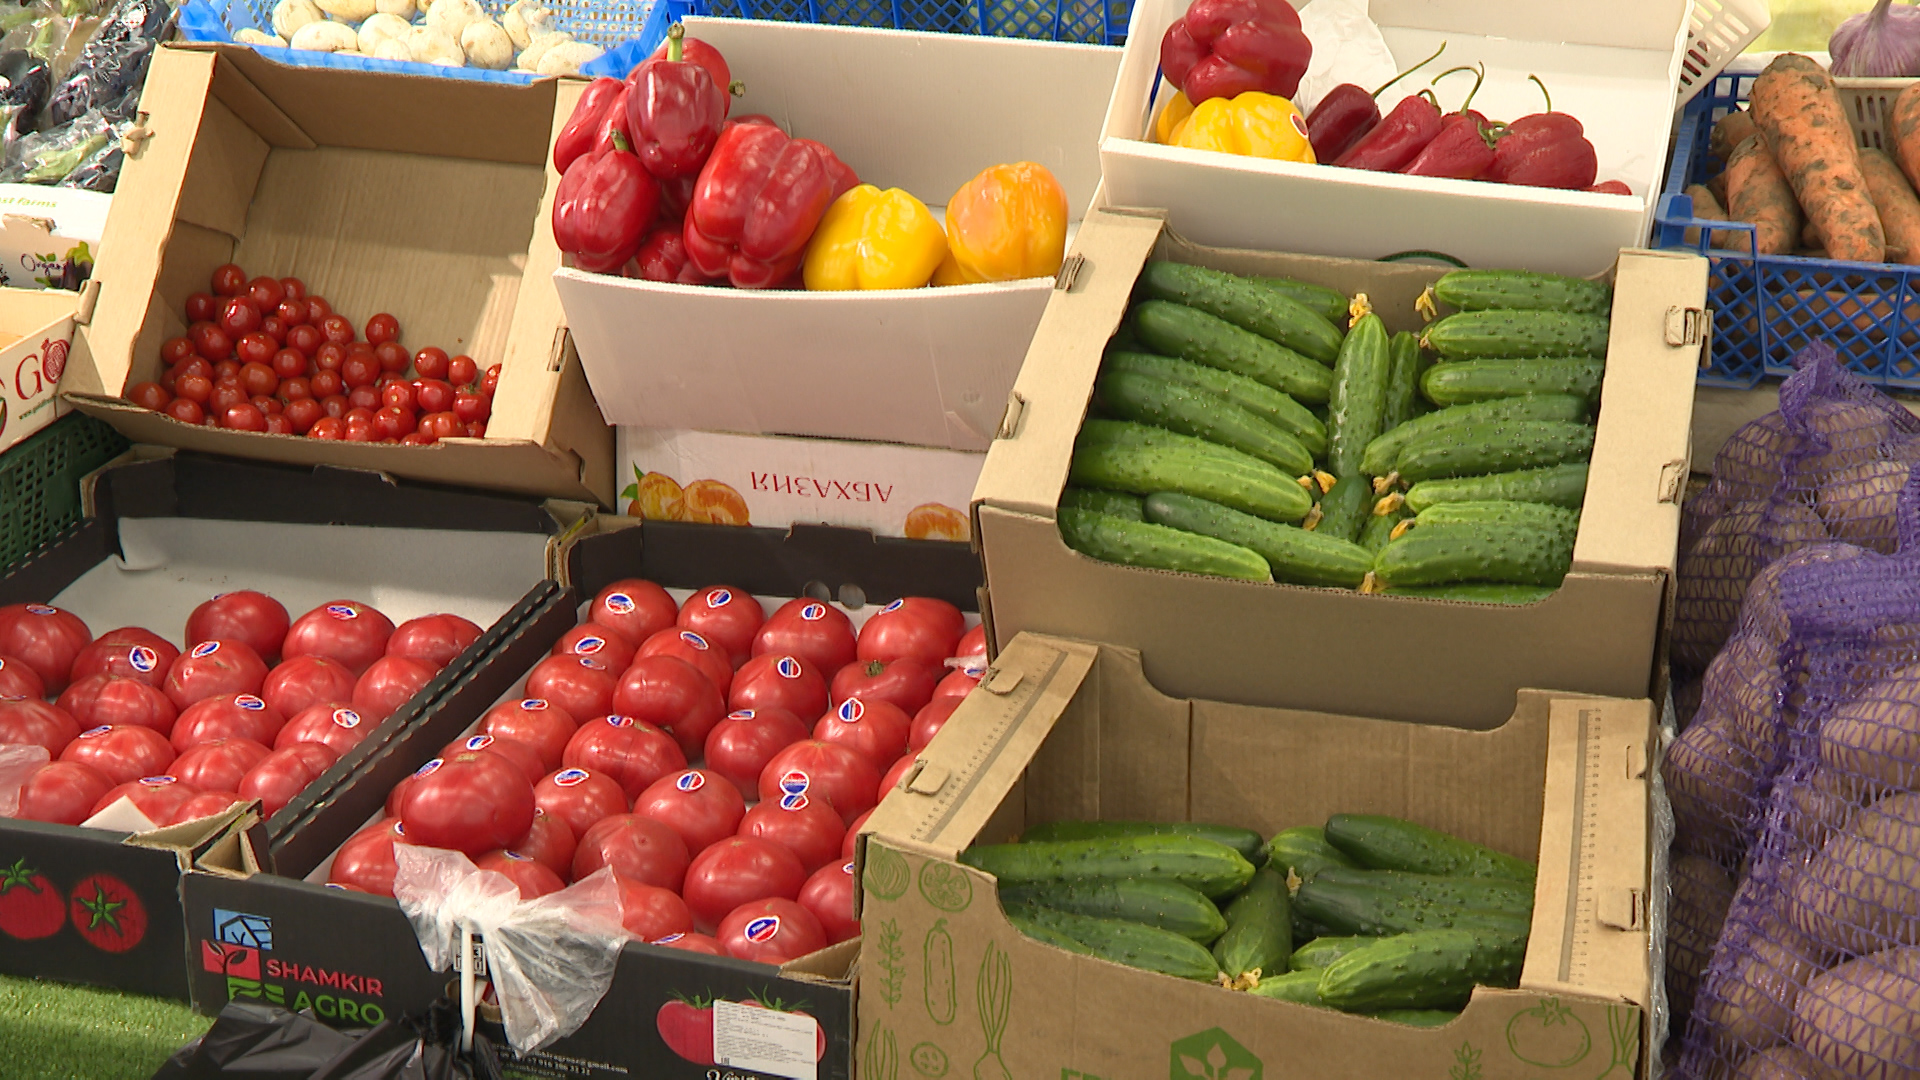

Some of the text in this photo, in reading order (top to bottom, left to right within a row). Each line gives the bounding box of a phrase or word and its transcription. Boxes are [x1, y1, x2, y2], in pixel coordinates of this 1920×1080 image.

[18, 196, 58, 208] farms
[750, 471, 893, 503] АБХАЗИЯ
[266, 959, 384, 998] SHAMKIR
[293, 990, 386, 1026] AGRO
